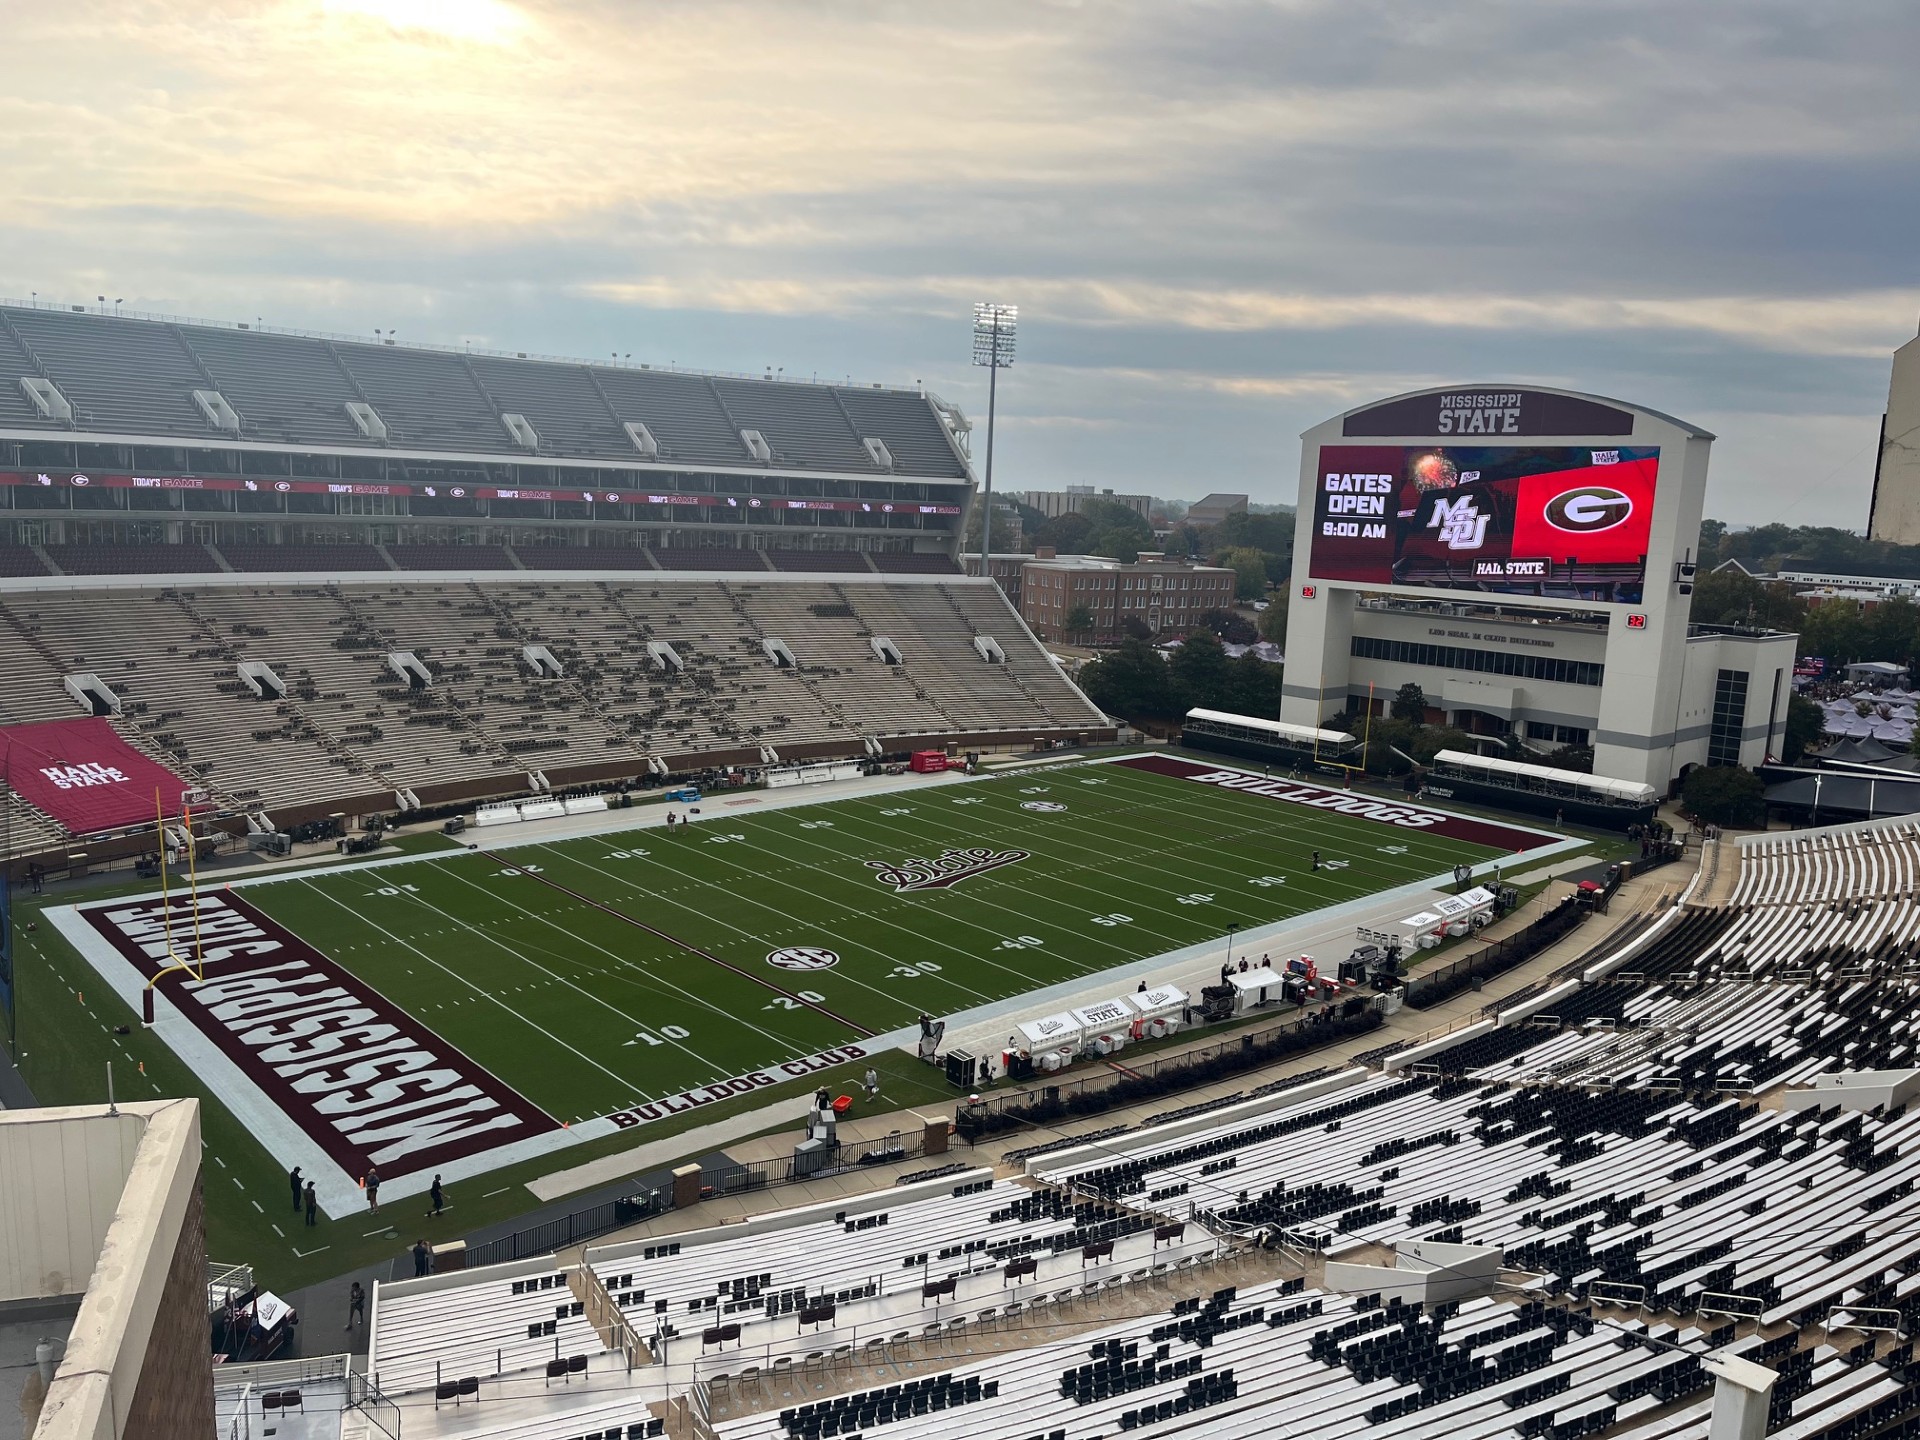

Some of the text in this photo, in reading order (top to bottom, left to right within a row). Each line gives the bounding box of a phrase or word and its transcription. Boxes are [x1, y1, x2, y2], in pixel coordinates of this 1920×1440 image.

[1440, 394, 1522, 408] MISSISSIPPI
[1438, 408, 1520, 433] STATE
[132, 477, 203, 488] TODAY'S GAME
[328, 484, 389, 494] TODAY'S GAME
[1325, 473, 1392, 493] GATES
[497, 490, 551, 499] TODAY'S GAME
[648, 495, 698, 504] TODAY'S GAME
[1328, 495, 1385, 515] OPEN
[1323, 522, 1386, 539] 9:00 AM
[1476, 562, 1544, 575] HAIL STATE
[1303, 587, 1313, 596] 32
[1629, 615, 1643, 627] 32
[1428, 628, 1445, 636] LEO
[1447, 630, 1470, 639] SEAL
[39, 762, 118, 781] HAIL
[53, 770, 131, 790] STATE
[1186, 771, 1446, 827] BULLDOGS
[710, 833, 746, 844] 40
[612, 848, 651, 860] 30
[502, 864, 544, 877] 20
[863, 847, 1031, 892] State
[1248, 876, 1285, 887] 30
[376, 884, 420, 897] 10
[1176, 893, 1213, 905] 40
[1090, 912, 1134, 927] 50
[1004, 935, 1044, 950] 40
[774, 947, 834, 970] SEC
[893, 961, 943, 978] 30
[772, 990, 826, 1010] 20
[1081, 1002, 1115, 1015] MISSISSIPPI
[1087, 1008, 1123, 1023] STATE
[103, 896, 523, 1166] MISSISSIPPI STATE
[1037, 1020, 1064, 1035] State
[635, 1025, 691, 1046] 10
[604, 1046, 867, 1129] BULLDOG CLUB
